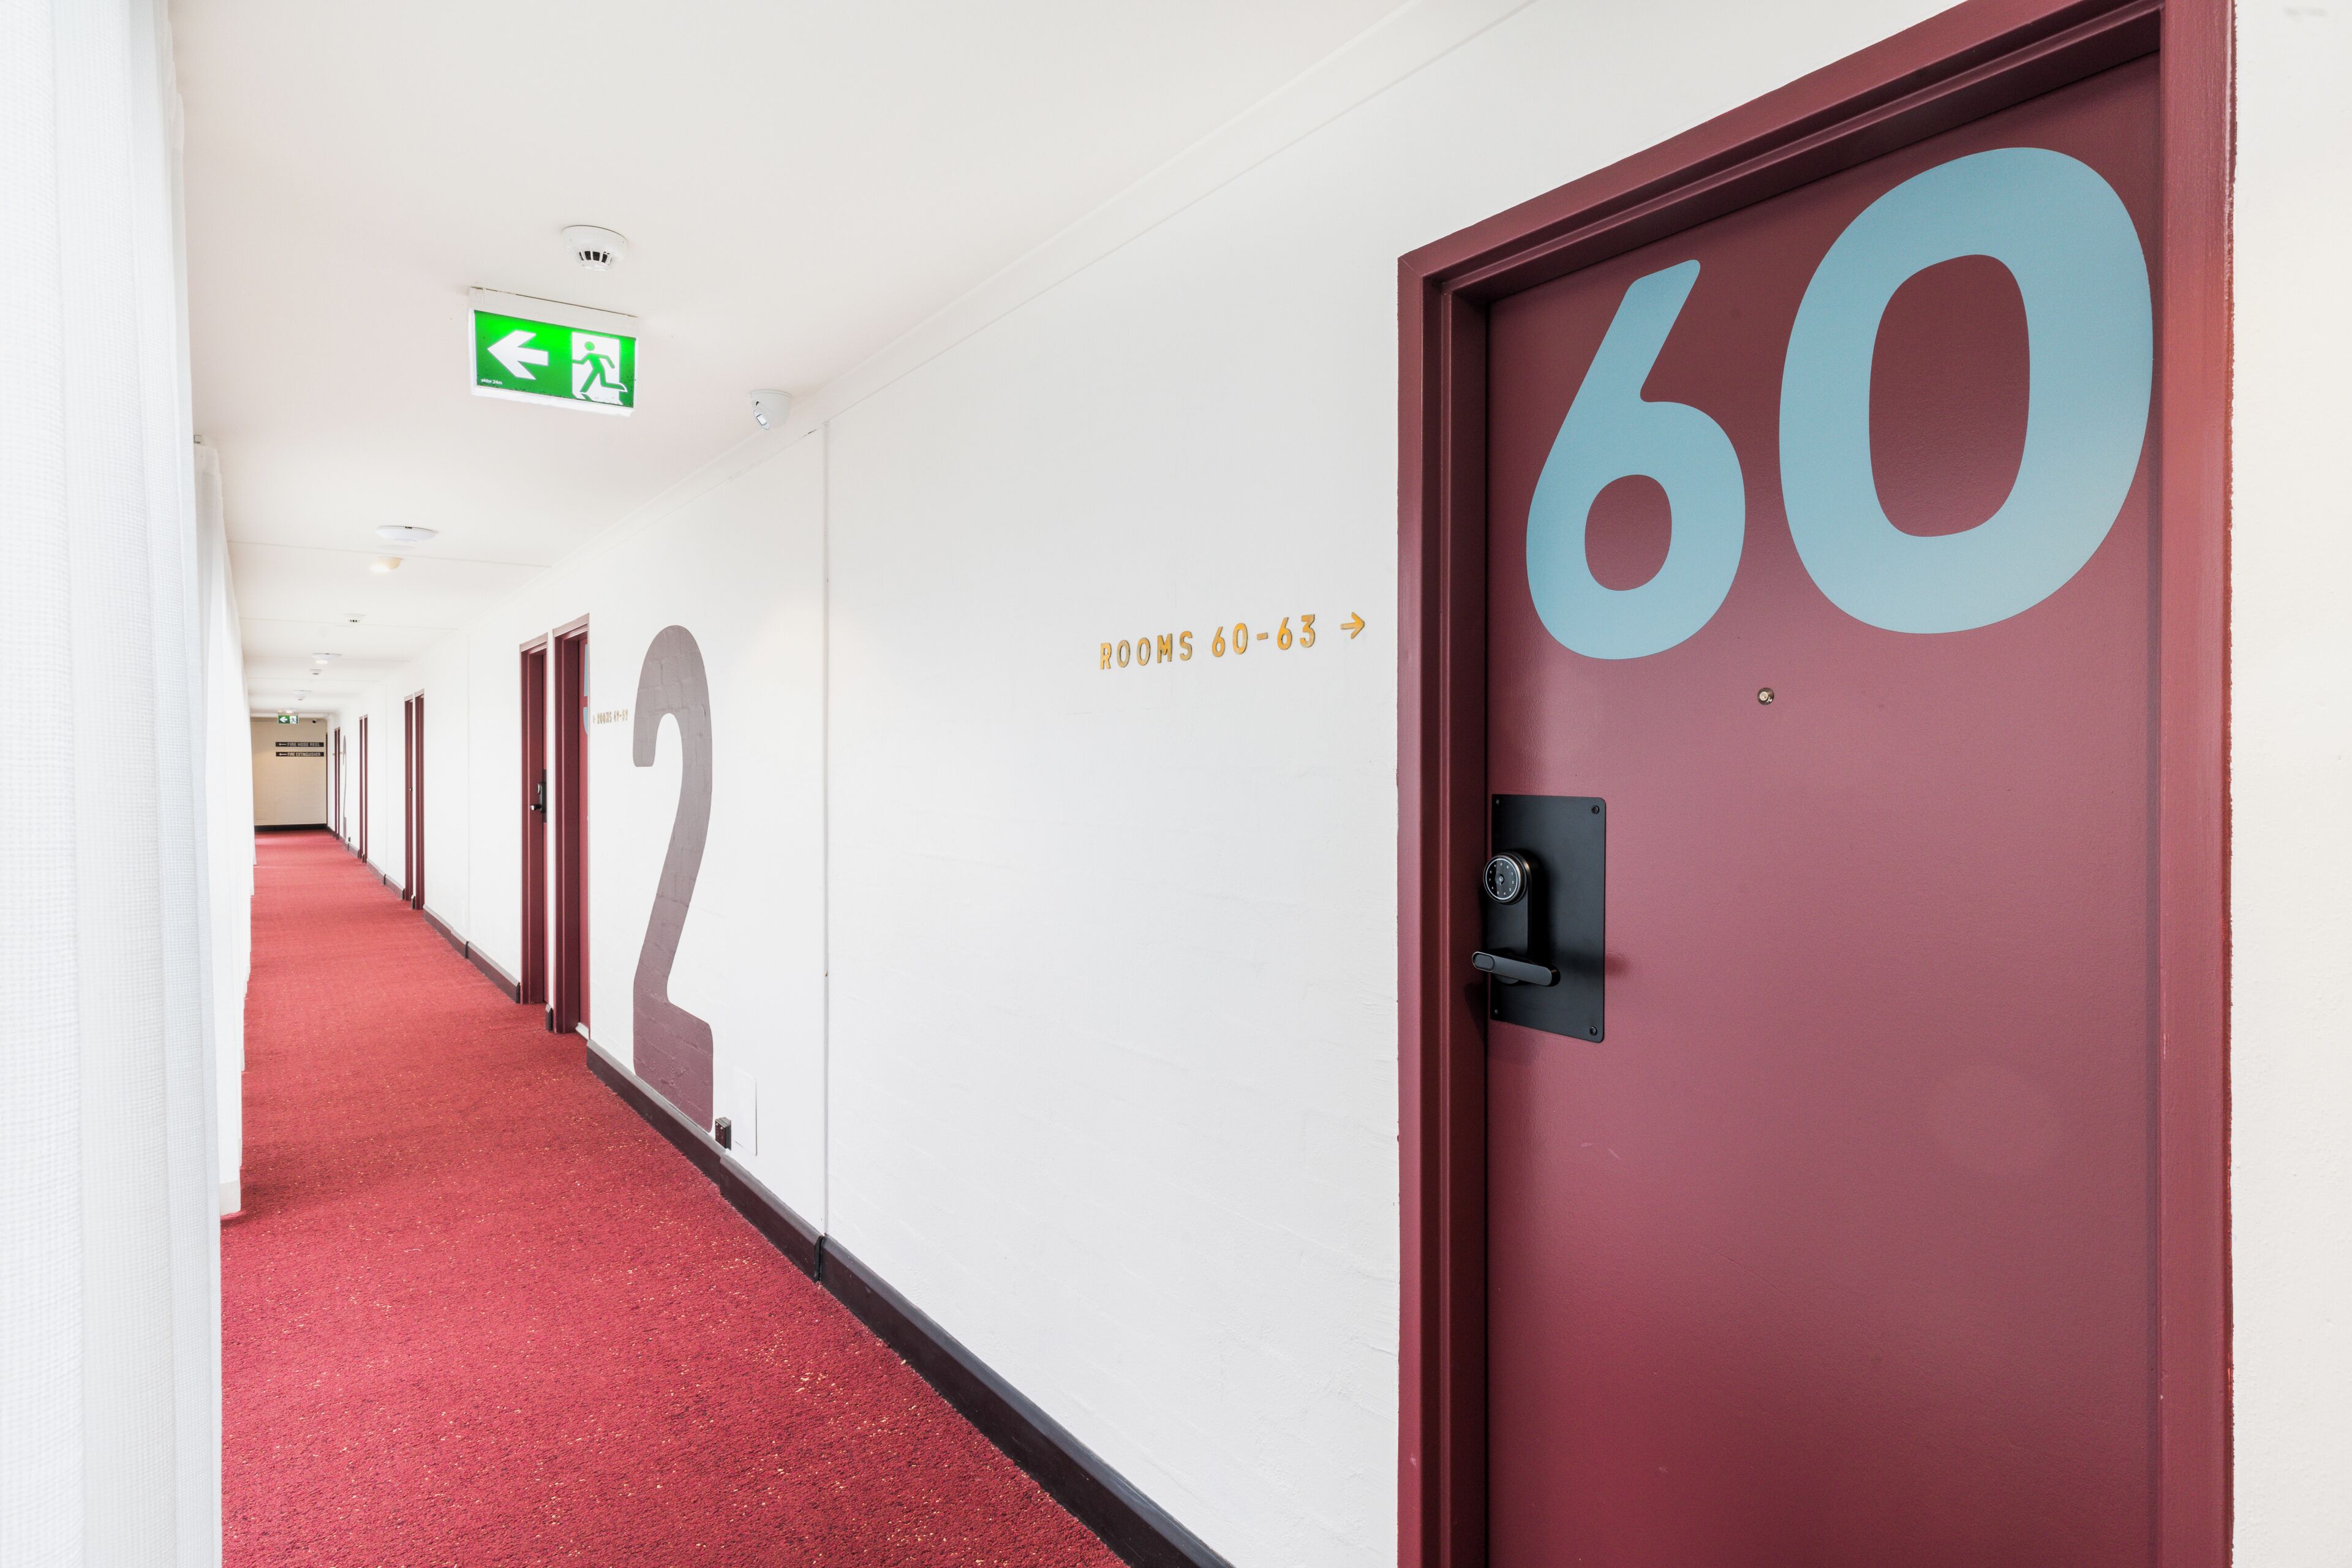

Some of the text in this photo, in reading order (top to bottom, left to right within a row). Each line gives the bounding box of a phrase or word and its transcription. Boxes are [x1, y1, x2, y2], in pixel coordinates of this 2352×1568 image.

[1100, 614, 1316, 670] ROOMS 60-63
[1526, 148, 2154, 660] 60
[633, 625, 713, 1133] 2
